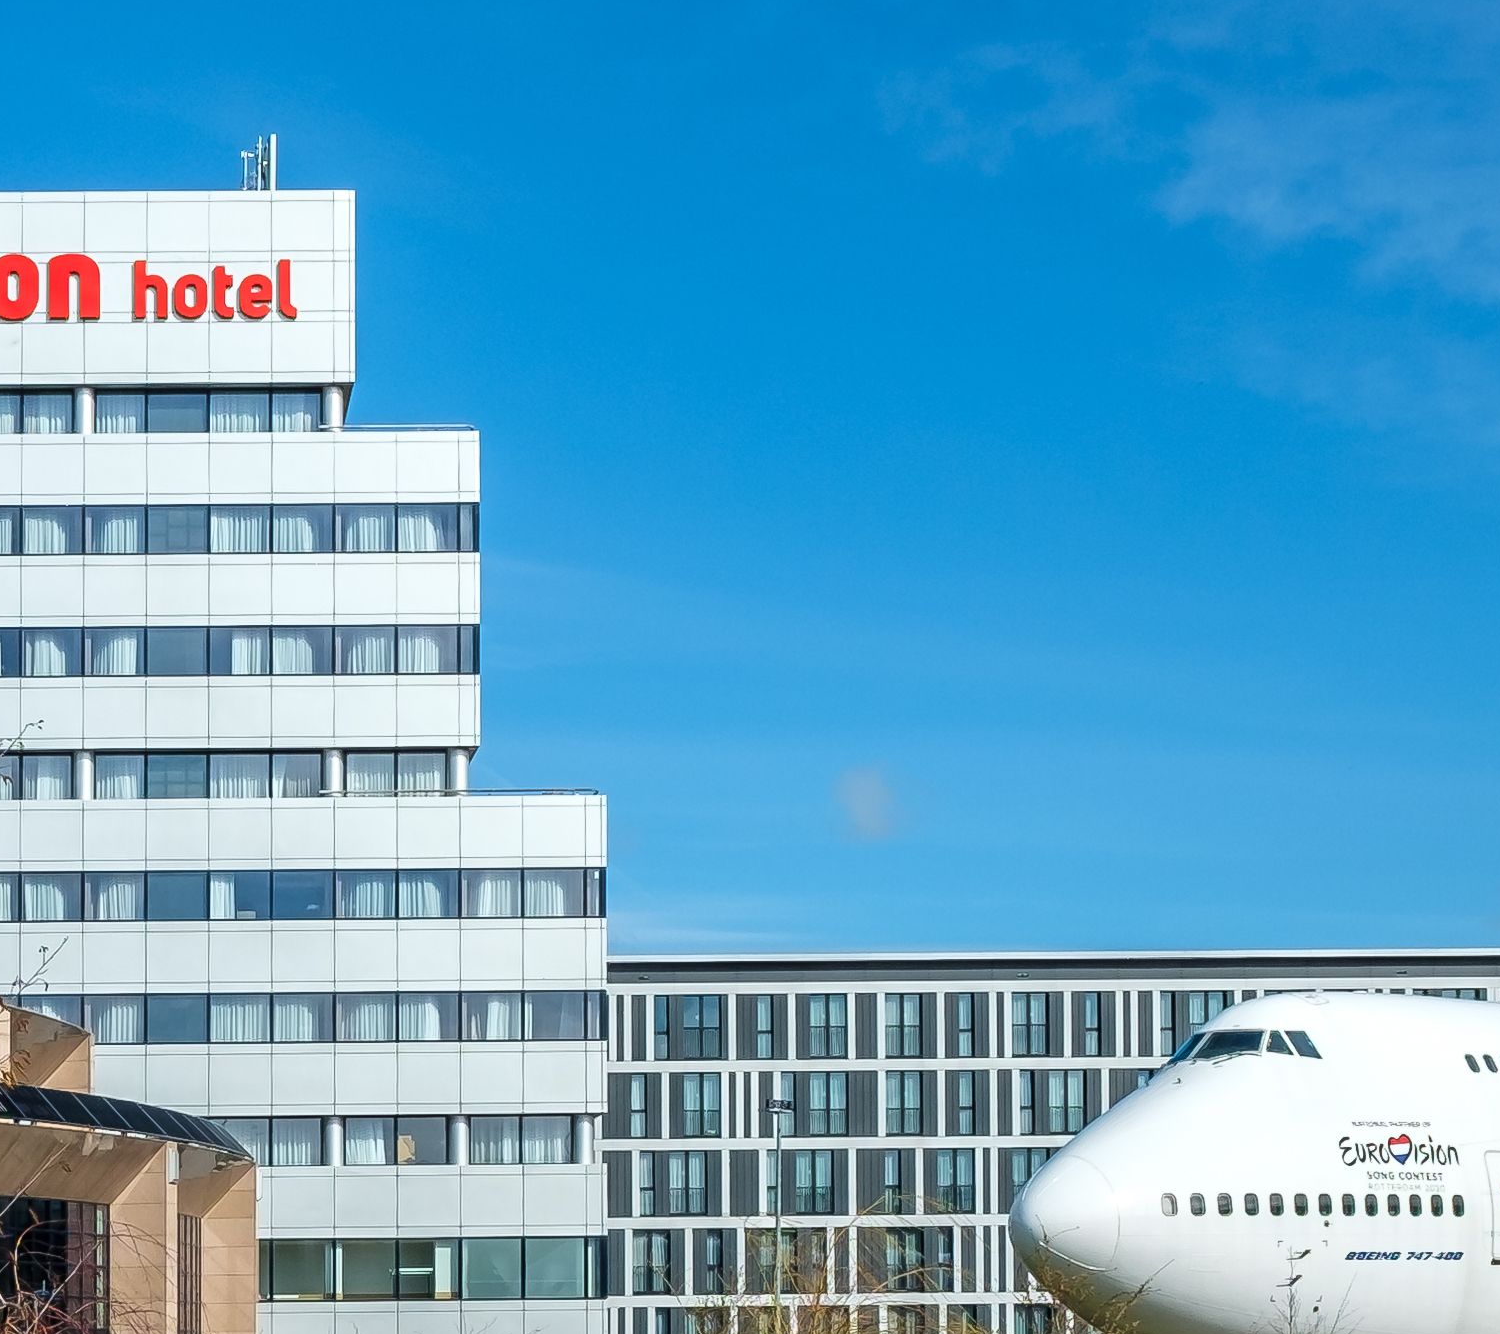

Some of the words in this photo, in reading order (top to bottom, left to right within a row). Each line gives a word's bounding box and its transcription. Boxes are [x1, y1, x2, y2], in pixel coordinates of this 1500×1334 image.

[132, 259, 298, 322] hotel
[1366, 1171, 1395, 1181] SONG
[1398, 1171, 1443, 1181] CONTEST
[1345, 1251, 1402, 1261] BOEING
[1406, 1251, 1465, 1261] 747-400
